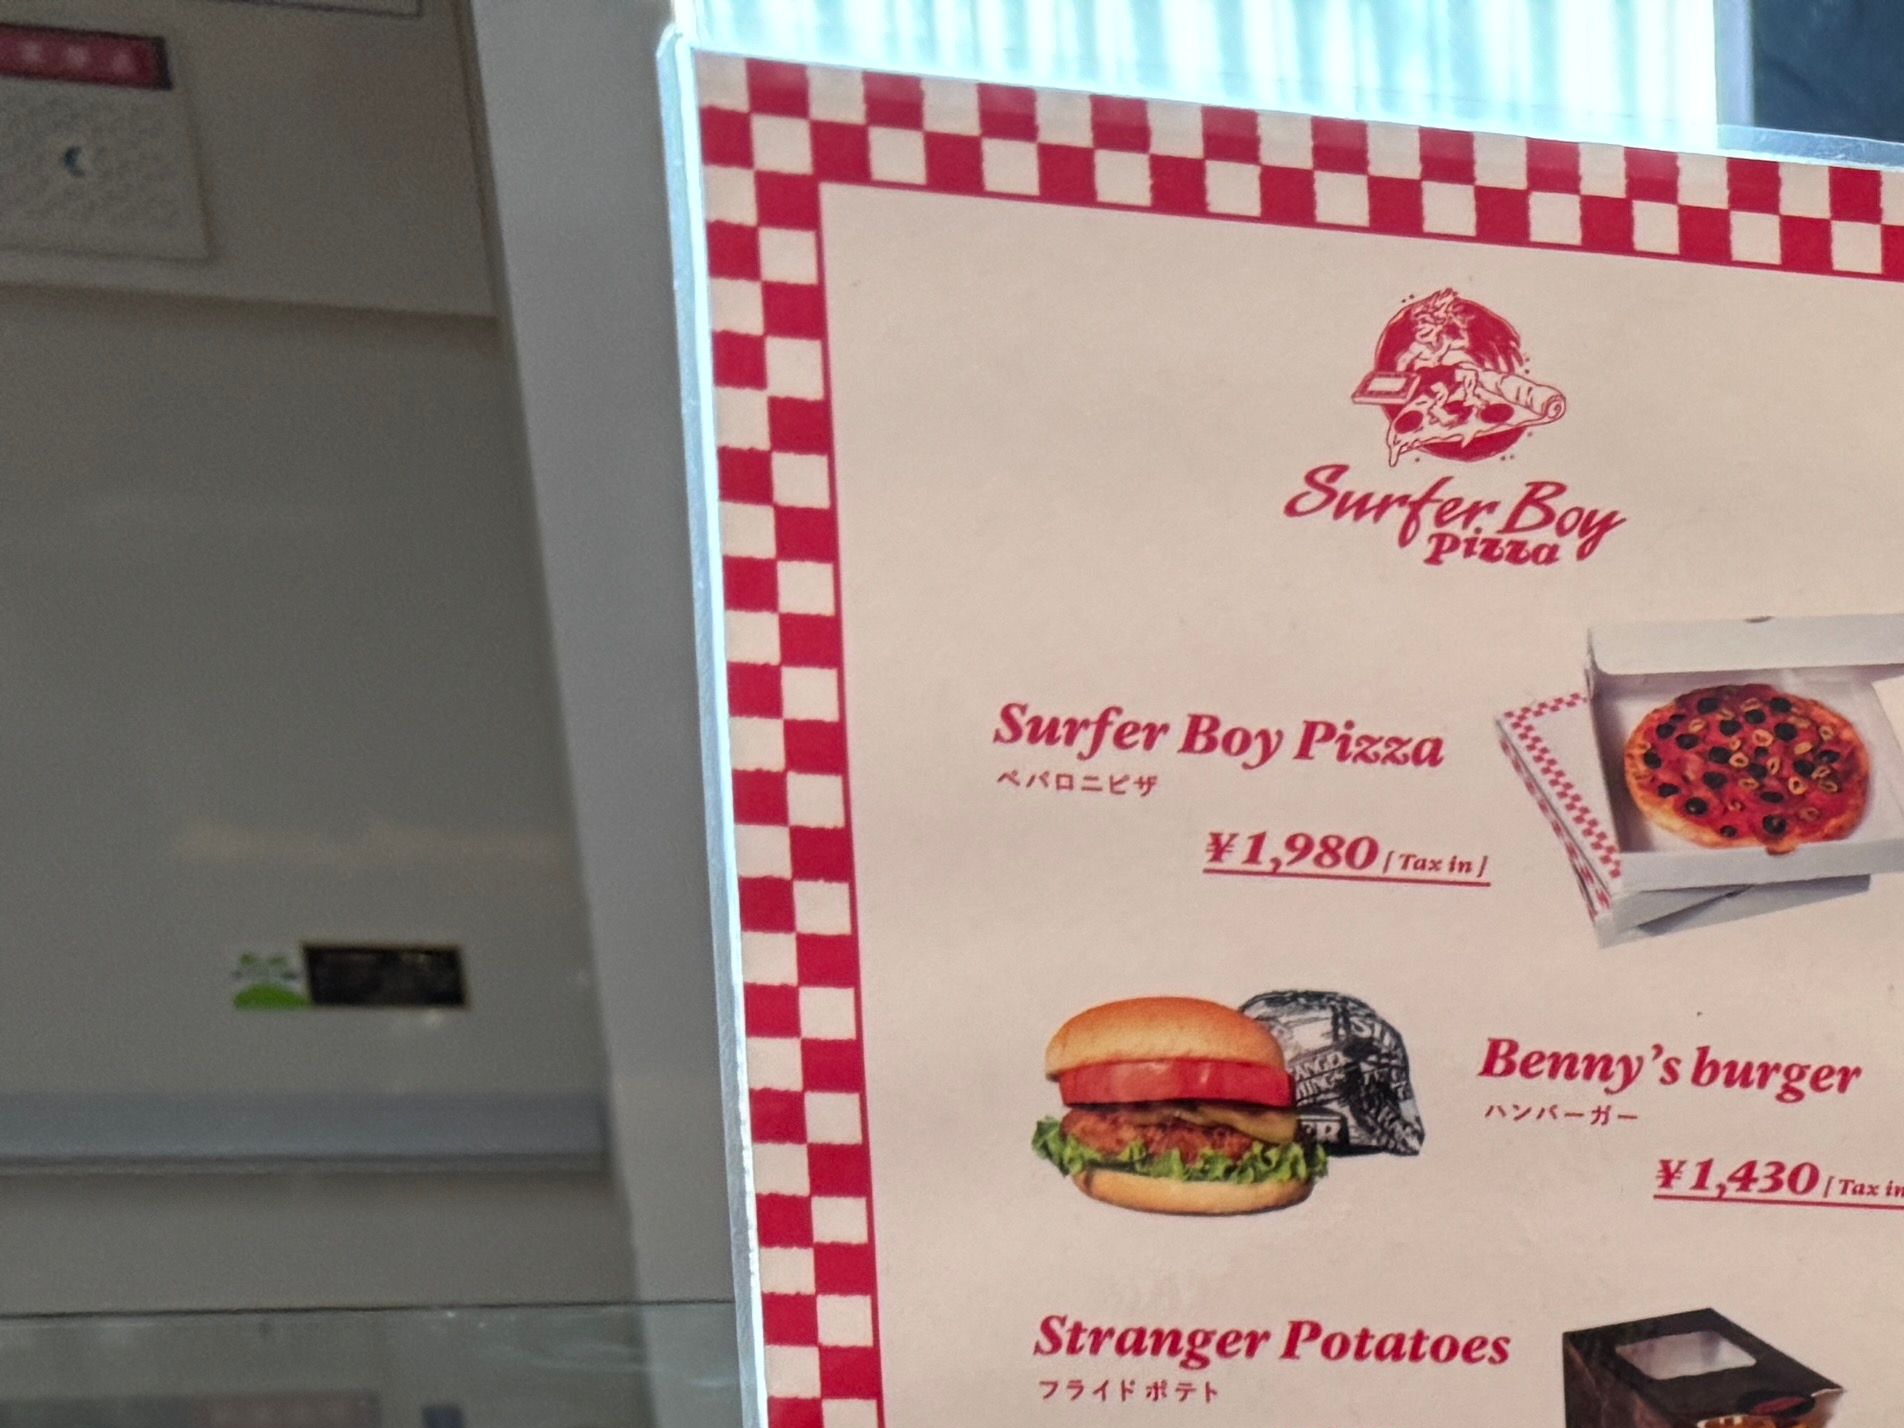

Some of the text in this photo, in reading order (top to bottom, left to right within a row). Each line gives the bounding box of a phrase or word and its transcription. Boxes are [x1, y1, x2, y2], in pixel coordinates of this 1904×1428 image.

[1283, 463, 1627, 561] Surfer Boy
[993, 702, 1446, 770] Surfer Boy Pizza
[1204, 829, 1380, 875] ¥1,980
[1478, 1036, 1863, 1104] Benny's burger
[1483, 1102, 1639, 1127] ハンバーガー
[1656, 1157, 1821, 1200] ¥1,430
[1033, 1313, 1512, 1371] Stranger Potatoes
[1037, 1378, 1219, 1404] フライドポテト
